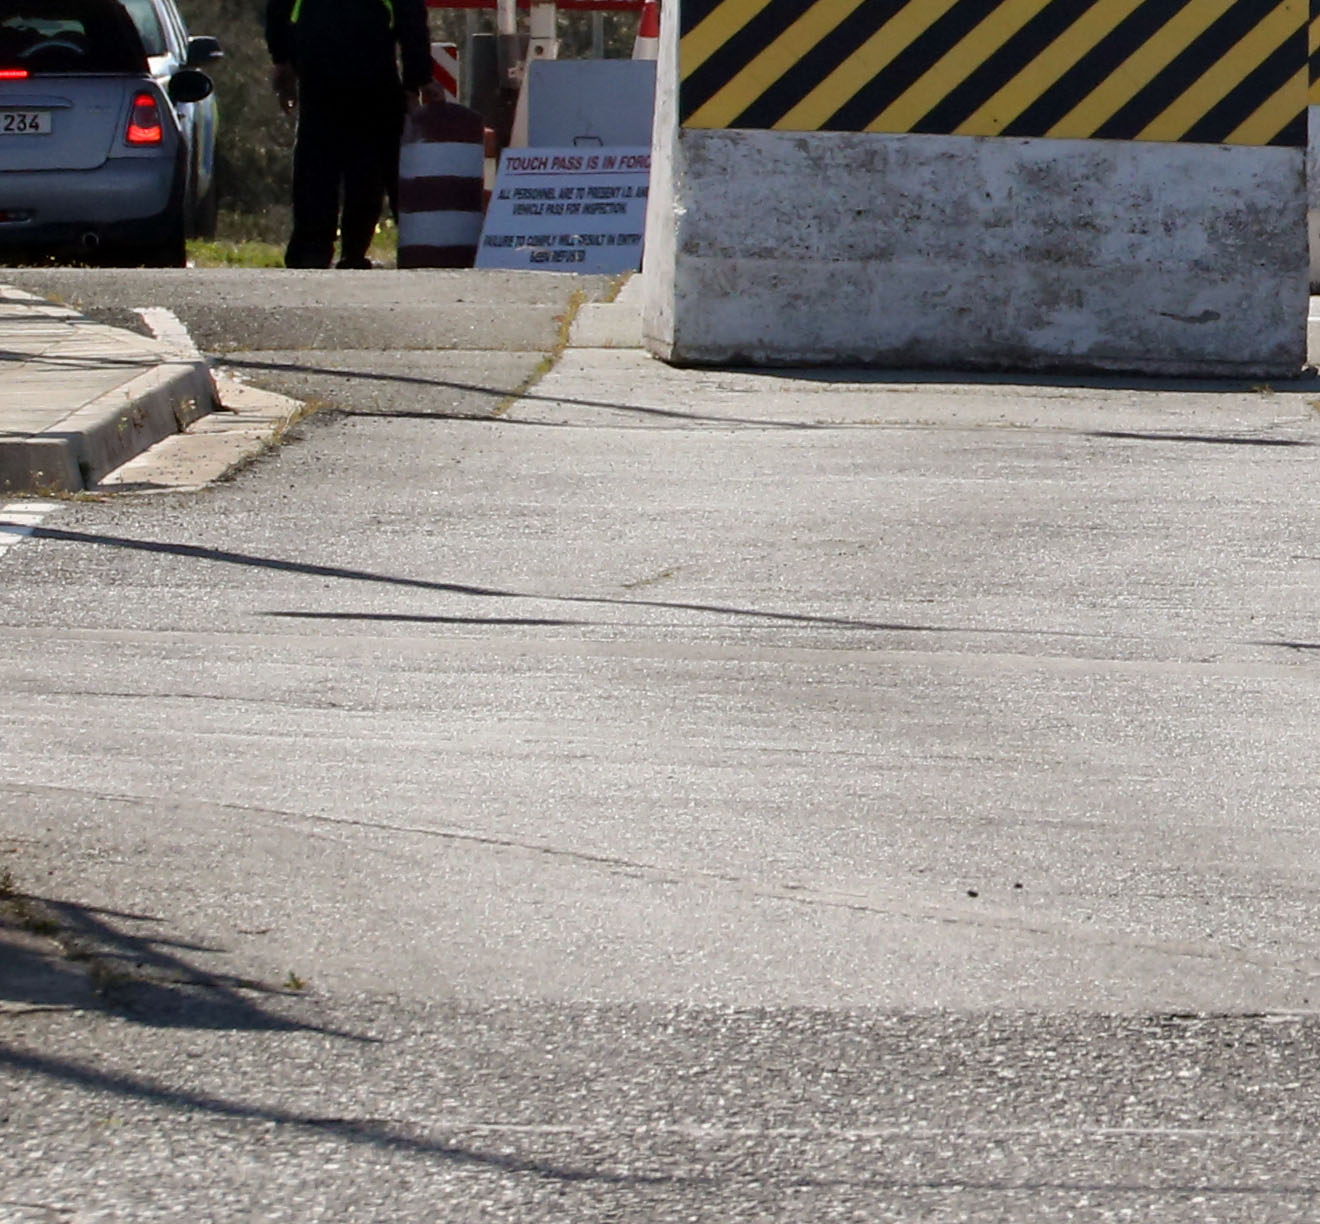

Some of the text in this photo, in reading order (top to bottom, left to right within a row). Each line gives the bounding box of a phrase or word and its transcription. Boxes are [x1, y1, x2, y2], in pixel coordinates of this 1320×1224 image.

[4, 114, 40, 132] 234
[506, 156, 650, 170] TOUCH PASS IS IN FORC
